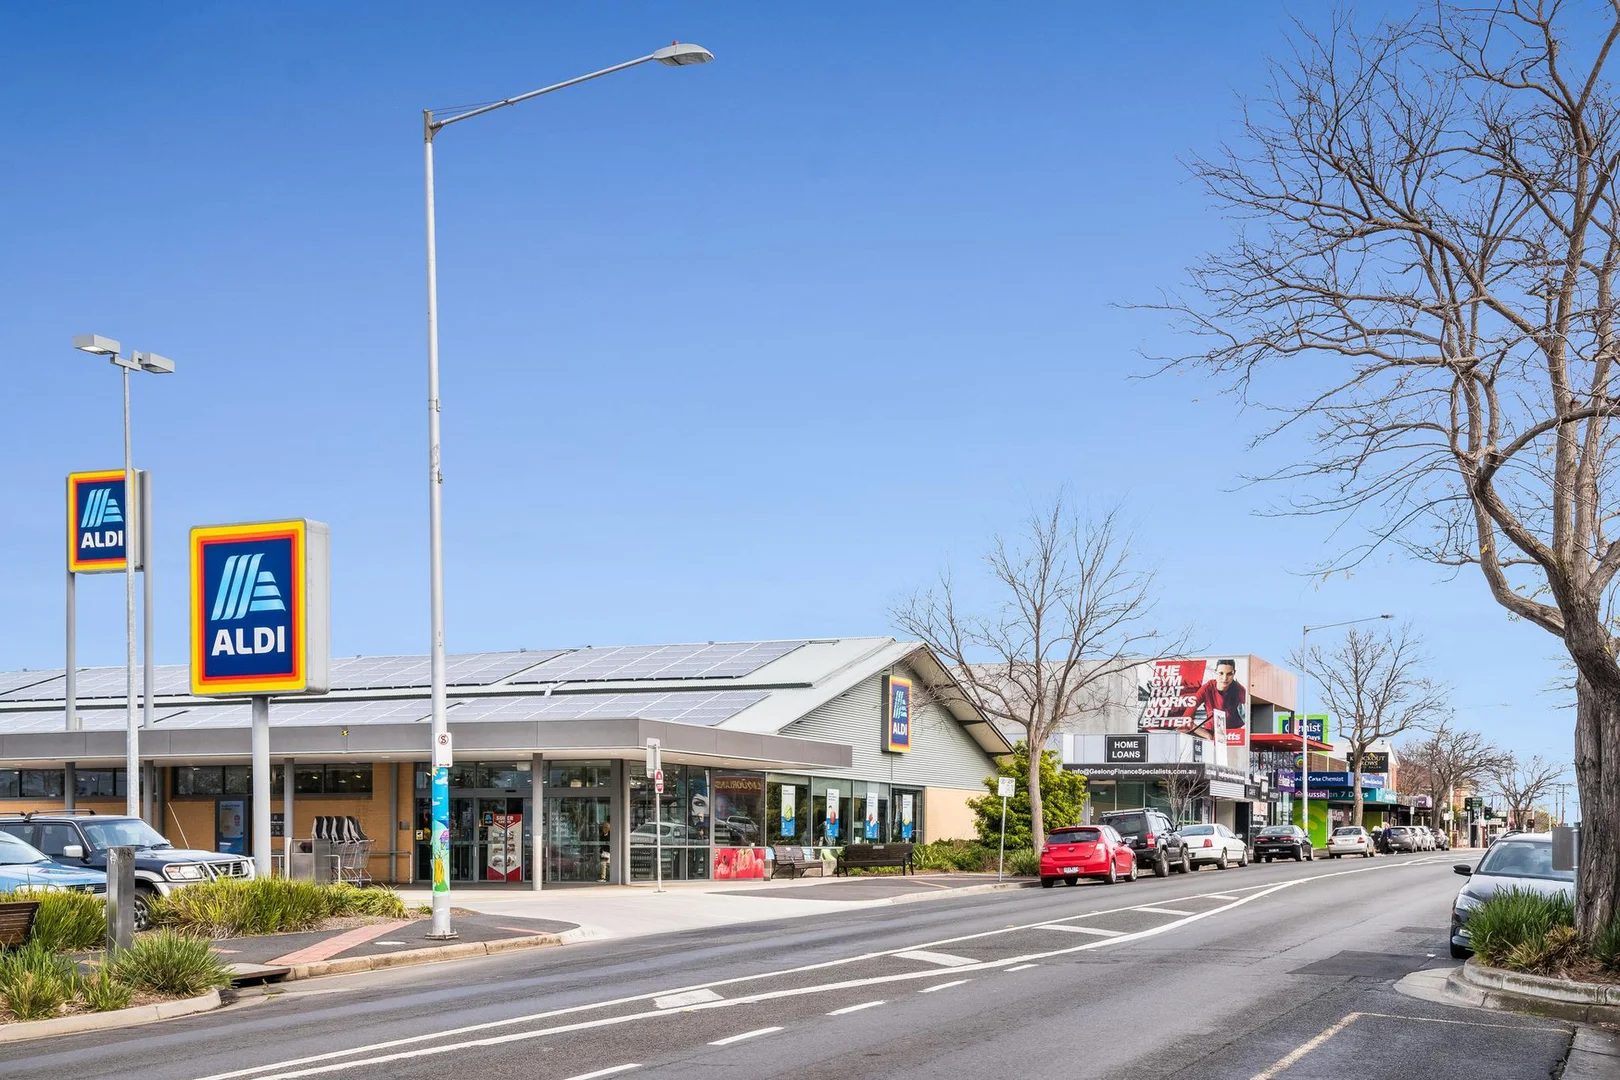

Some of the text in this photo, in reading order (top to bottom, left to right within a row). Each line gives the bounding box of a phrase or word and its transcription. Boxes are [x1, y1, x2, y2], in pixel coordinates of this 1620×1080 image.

[81, 530, 123, 549] ALDI
[211, 625, 285, 656] ALDI
[1154, 665, 1180, 676] THE
[1151, 675, 1182, 687] GYM
[1150, 686, 1184, 697] THAT
[1147, 696, 1197, 708] WORKS
[1144, 707, 1171, 718] OUT
[1142, 716, 1192, 728] BETTER
[892, 721, 908, 736] ALDI
[1114, 741, 1139, 749] HOME
[1112, 750, 1141, 759] LOANS
[1071, 768, 1197, 776] info@GeelongFinanceSpecialists.com.au
